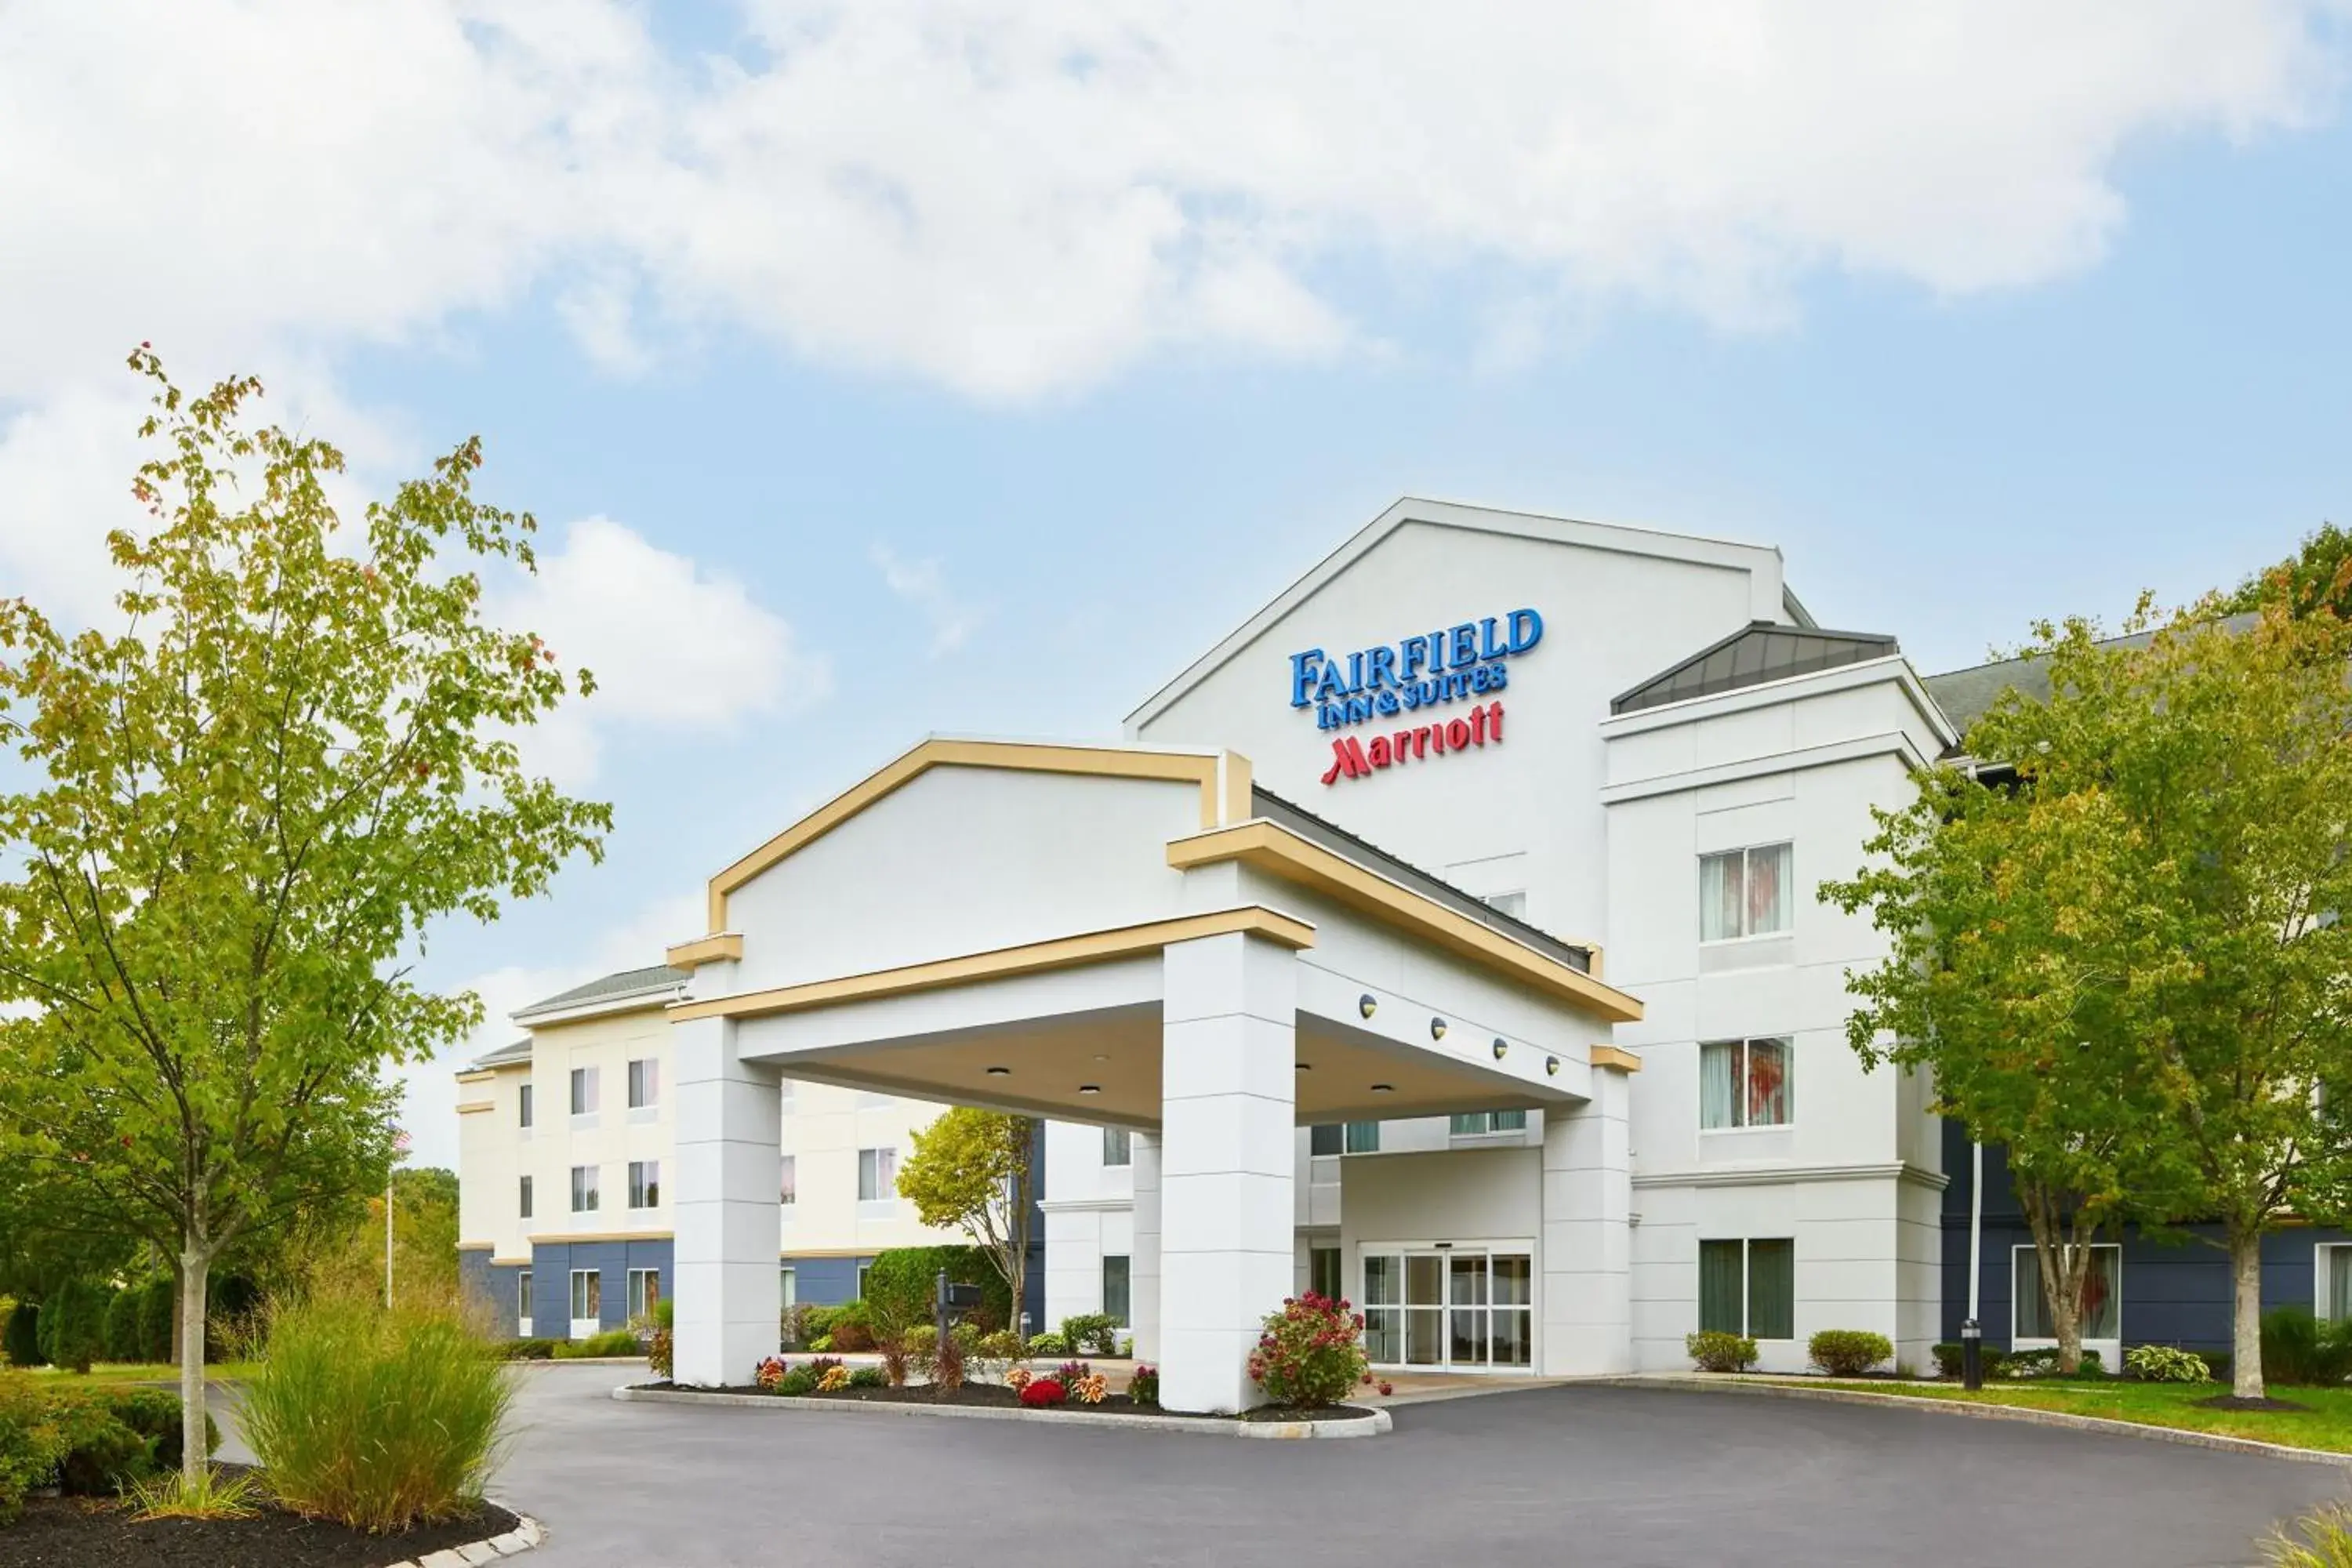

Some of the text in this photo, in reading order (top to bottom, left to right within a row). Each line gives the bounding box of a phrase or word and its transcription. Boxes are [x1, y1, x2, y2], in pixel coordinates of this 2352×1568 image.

[1290, 608, 1544, 707] FAIRFIELD
[1317, 662, 1507, 730] INN & SUITES
[1321, 700, 1504, 785] Marriott
